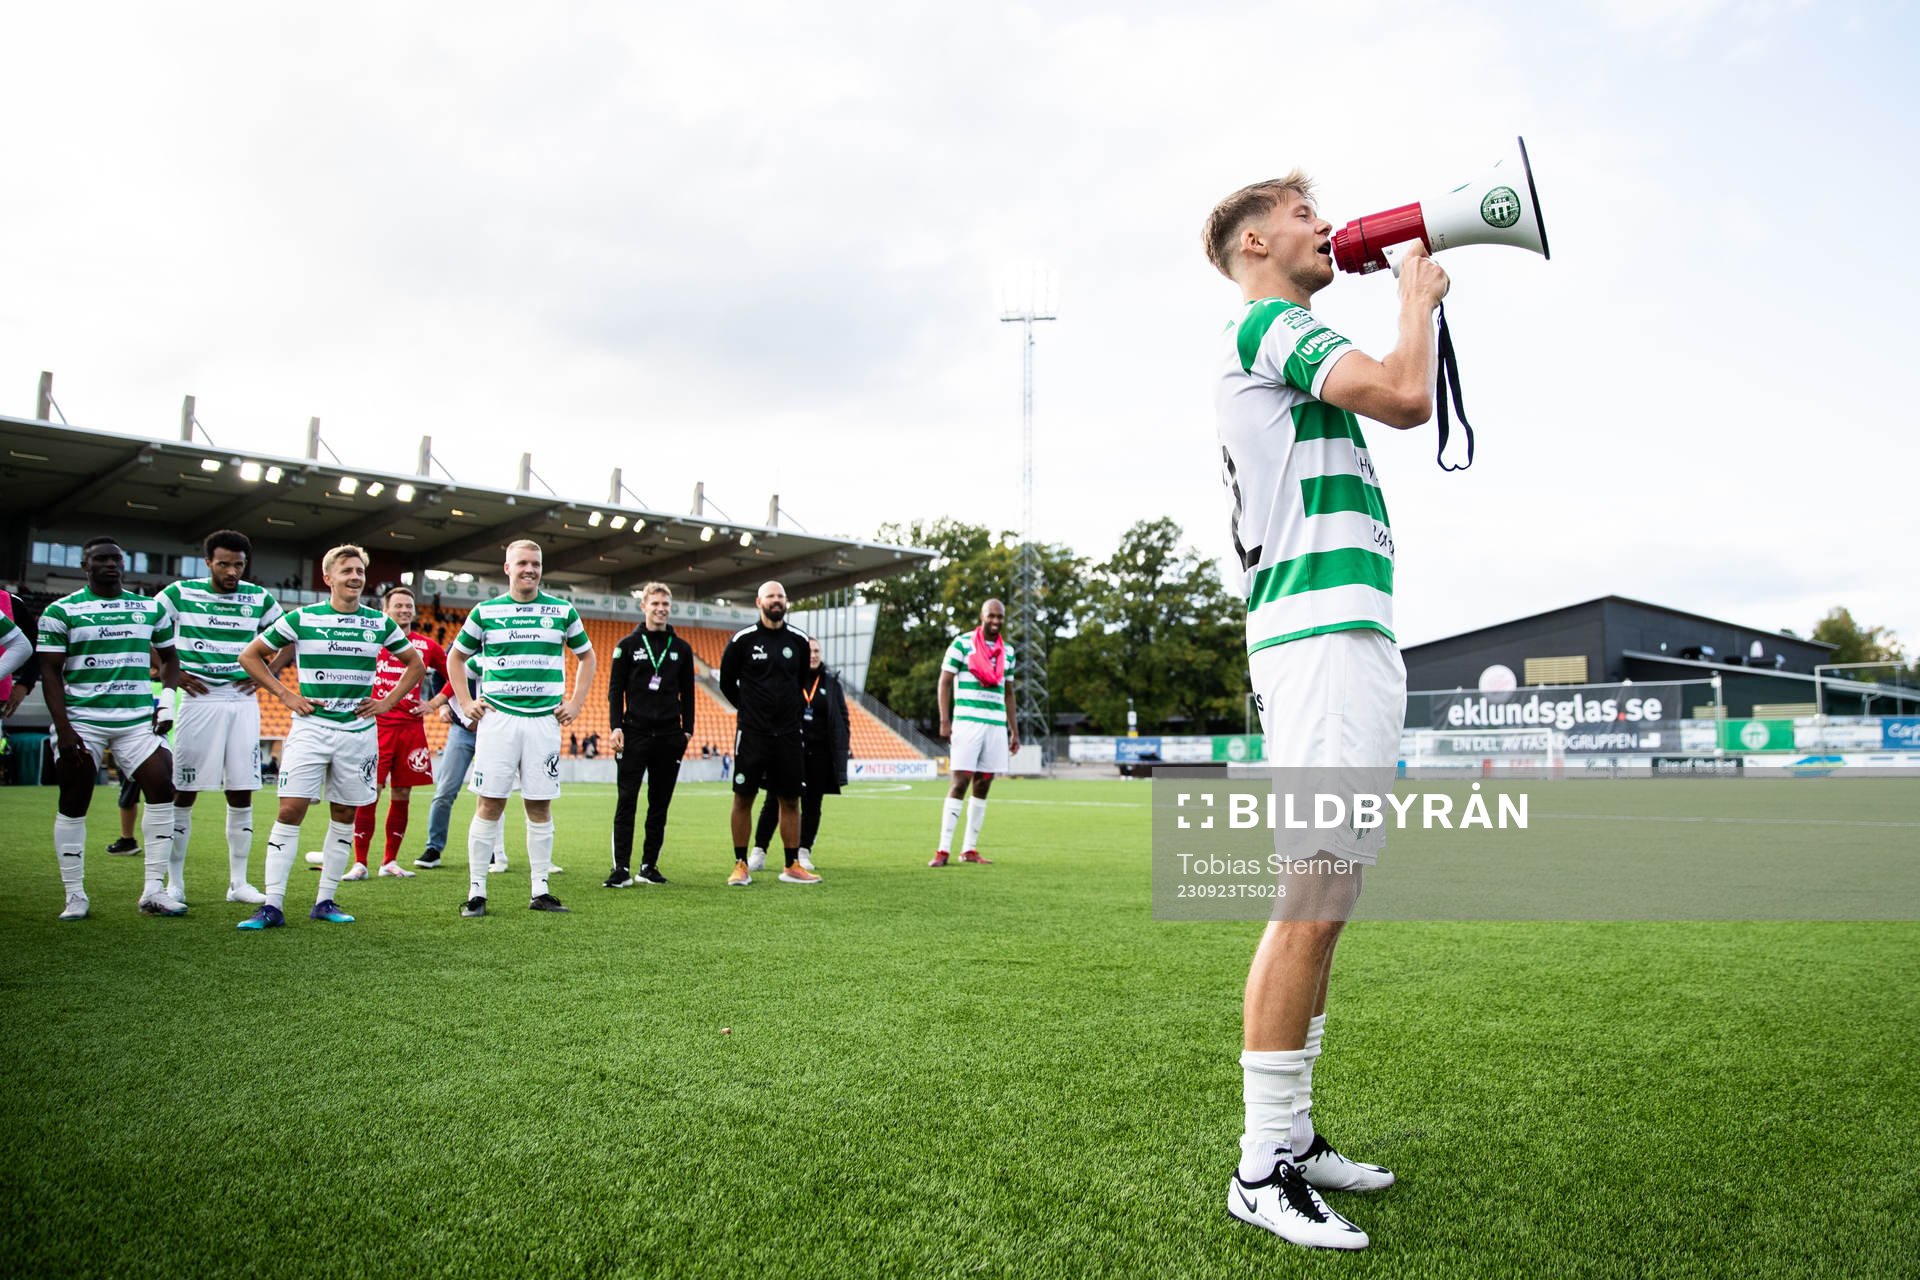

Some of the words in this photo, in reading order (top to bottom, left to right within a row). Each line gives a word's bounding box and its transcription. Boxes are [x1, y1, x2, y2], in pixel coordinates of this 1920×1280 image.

[1301, 330, 1337, 355] UNIBE
[1448, 693, 1662, 729] eklundsglas.se
[865, 763, 928, 774] INTERSPORT
